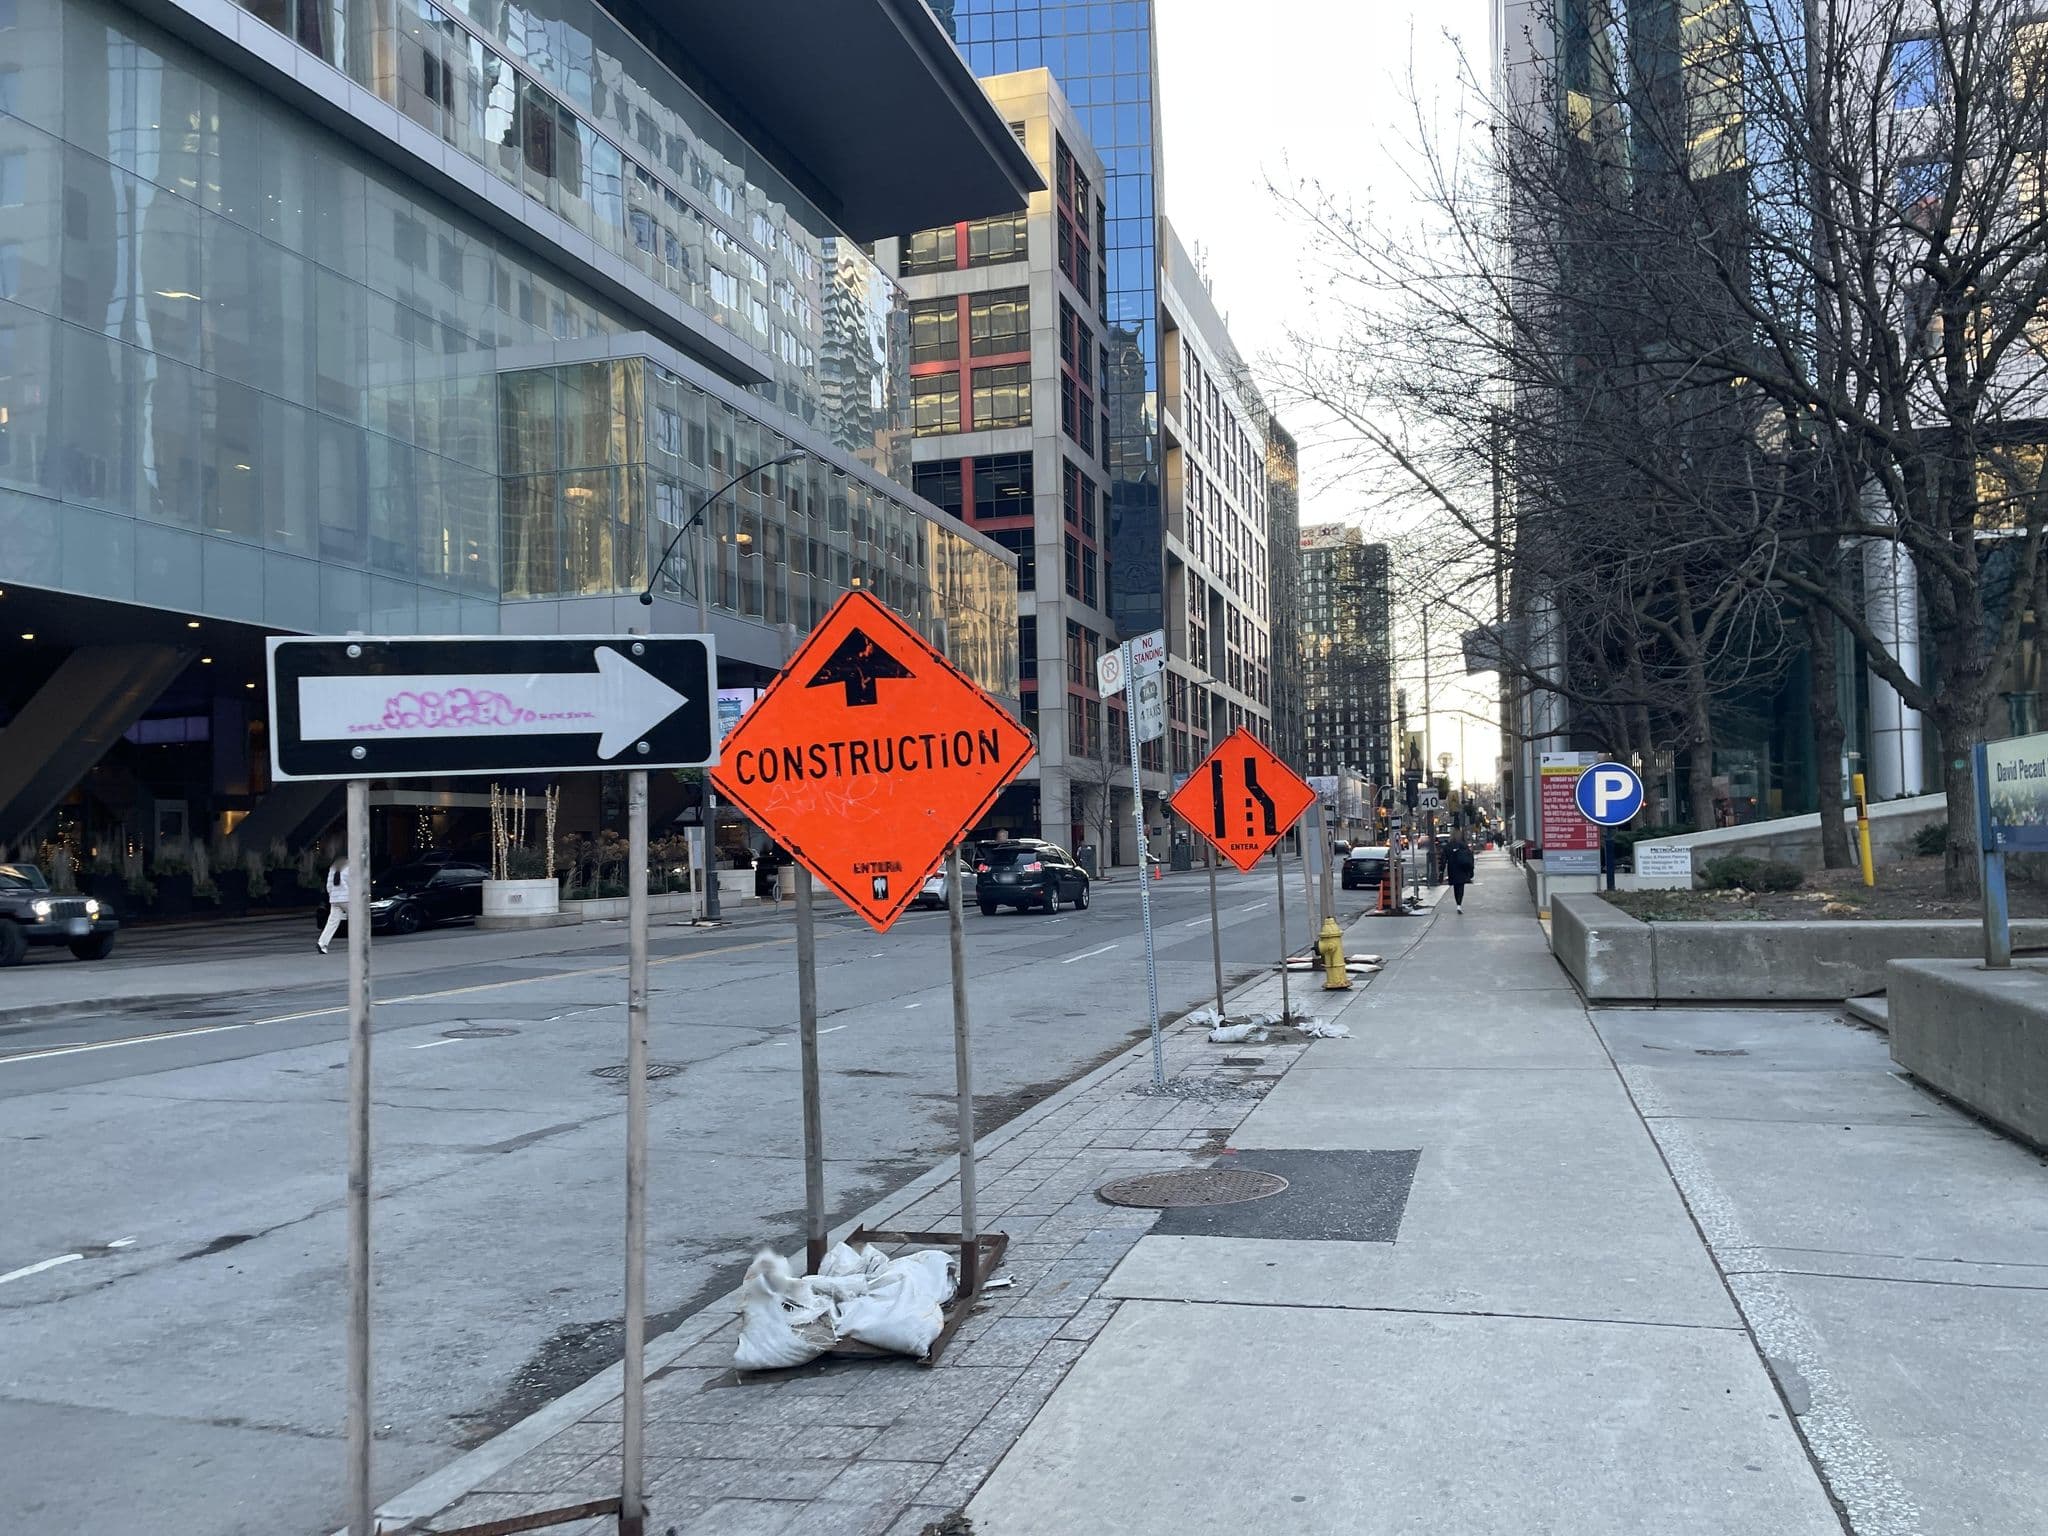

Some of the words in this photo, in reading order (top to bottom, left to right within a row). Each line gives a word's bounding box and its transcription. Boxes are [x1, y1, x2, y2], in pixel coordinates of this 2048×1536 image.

[1142, 637, 1153, 649] NO
[1134, 647, 1163, 665] STANDING
[1997, 760, 2017, 781] David
[2019, 758, 2047, 779] Pecaut
[1422, 797, 1438, 808] 40
[1230, 843, 1259, 851] ENTERA
